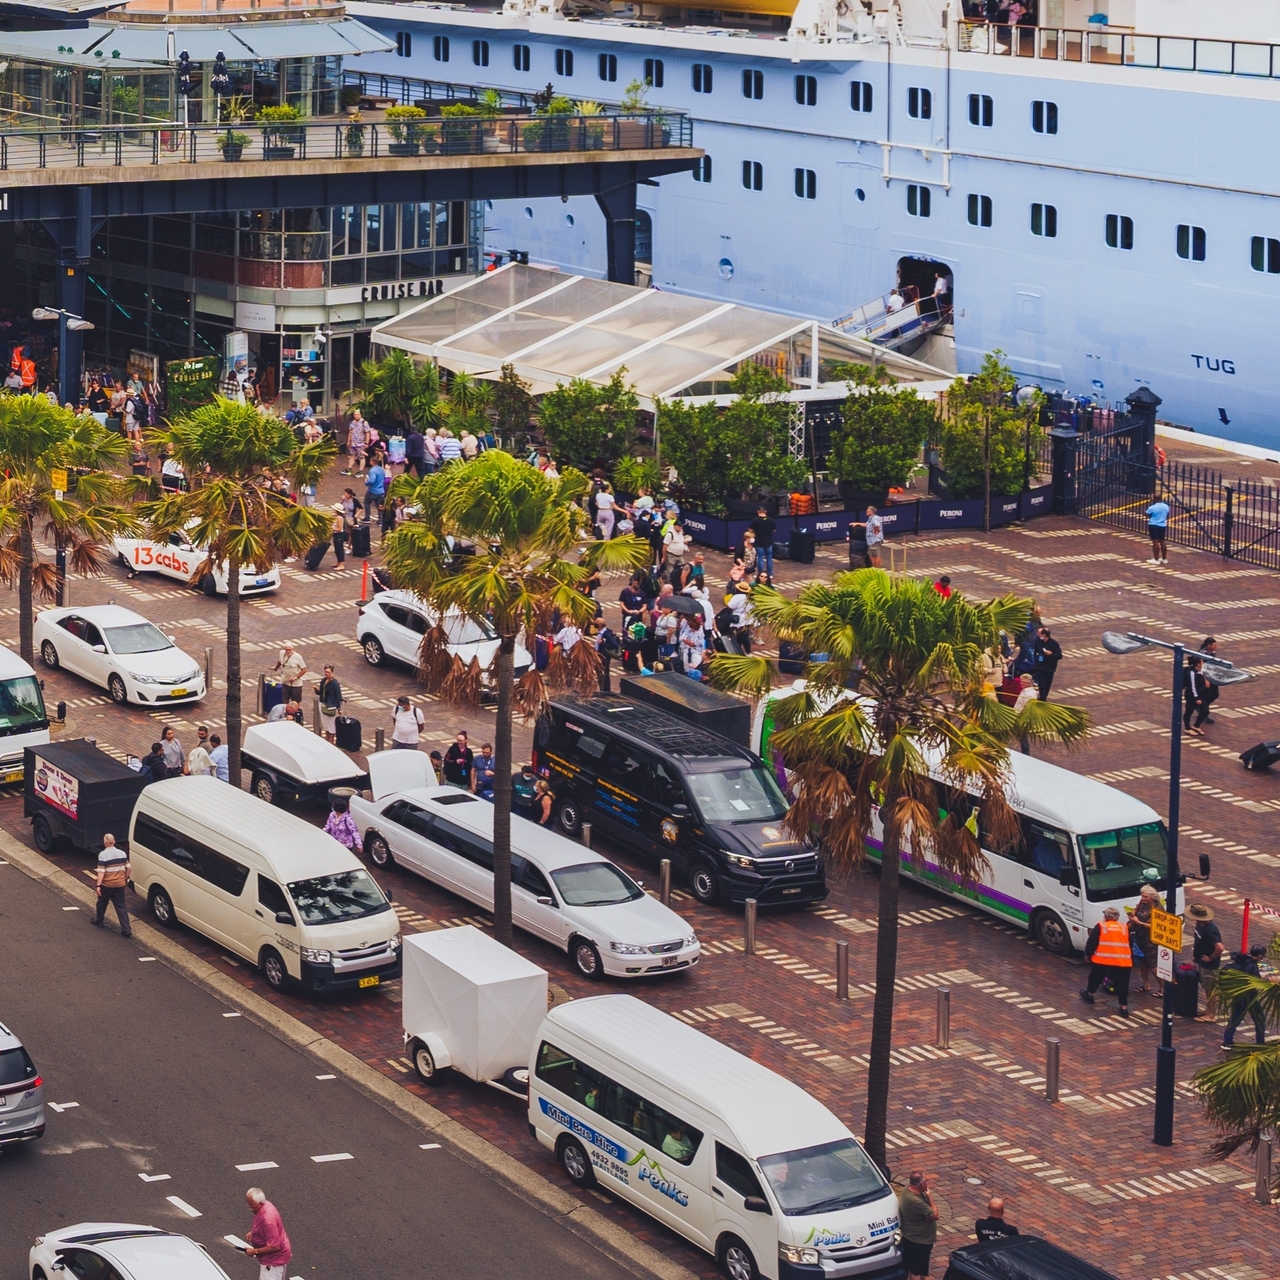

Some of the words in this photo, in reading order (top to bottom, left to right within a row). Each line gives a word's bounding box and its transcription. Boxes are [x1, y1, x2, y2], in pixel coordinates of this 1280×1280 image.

[361, 281, 414, 302] CRUISE
[419, 277, 444, 296] BAR
[1191, 354, 1235, 375] TUG
[174, 372, 199, 383] CRUISE
[201, 371, 213, 379] BAR
[1003, 502, 1017, 511] PERONI
[1031, 496, 1044, 505] PERONI
[940, 509, 962, 517] PERONI
[685, 518, 706, 531] PERONI
[816, 521, 837, 530] PERONI
[134, 547, 189, 574] 13cabs
[1154, 912, 1179, 926] DROP-OFF
[1156, 923, 1176, 935] PICK-UP
[1153, 932, 1164, 941] SHIP
[1165, 937, 1178, 948] DAYS
[25, 1091, 35, 1099] Uber
[547, 1104, 570, 1126] Mini
[572, 1120, 593, 1140] Bus
[595, 1134, 618, 1157] Hire
[591, 1150, 609, 1165] 4932
[611, 1161, 629, 1177] 9895
[592, 1160, 629, 1185] MAITLAND
[638, 1164, 688, 1207] Peaks
[868, 1220, 885, 1231] Mini
[886, 1216, 899, 1225] Bus
[813, 1231, 850, 1246] Peaks
